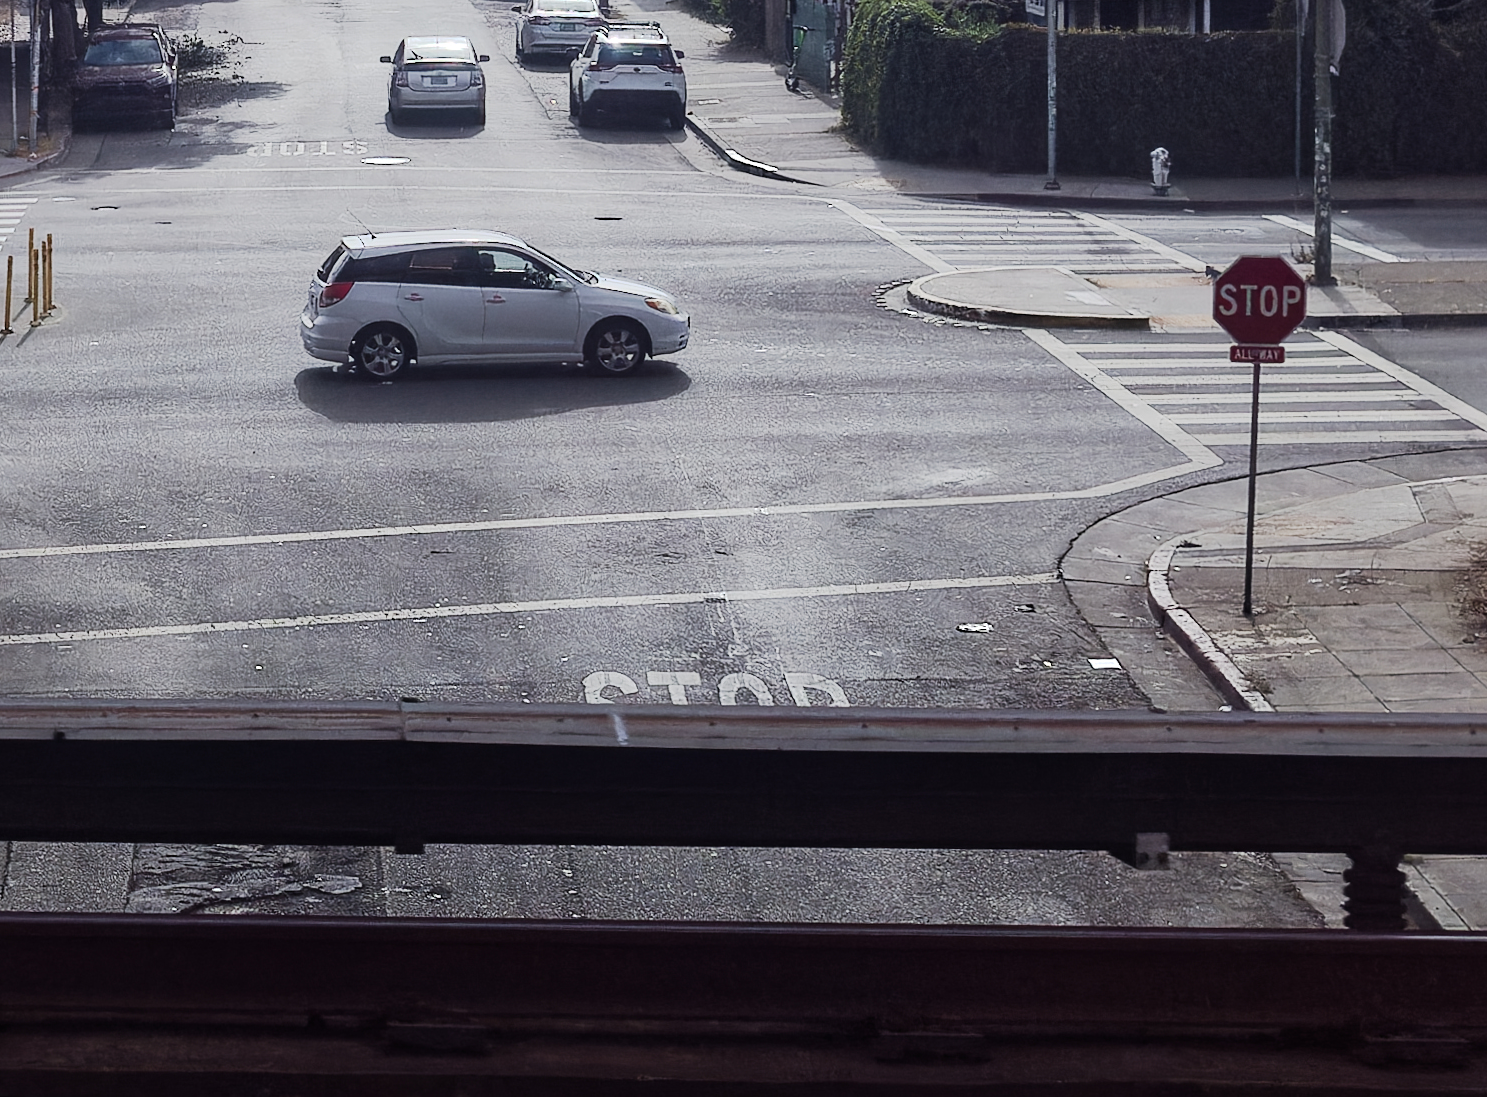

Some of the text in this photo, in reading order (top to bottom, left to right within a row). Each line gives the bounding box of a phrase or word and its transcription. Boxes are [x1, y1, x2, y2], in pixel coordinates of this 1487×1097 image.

[1218, 283, 1301, 318] STOP
[1234, 349, 1281, 361] ALL WAY
